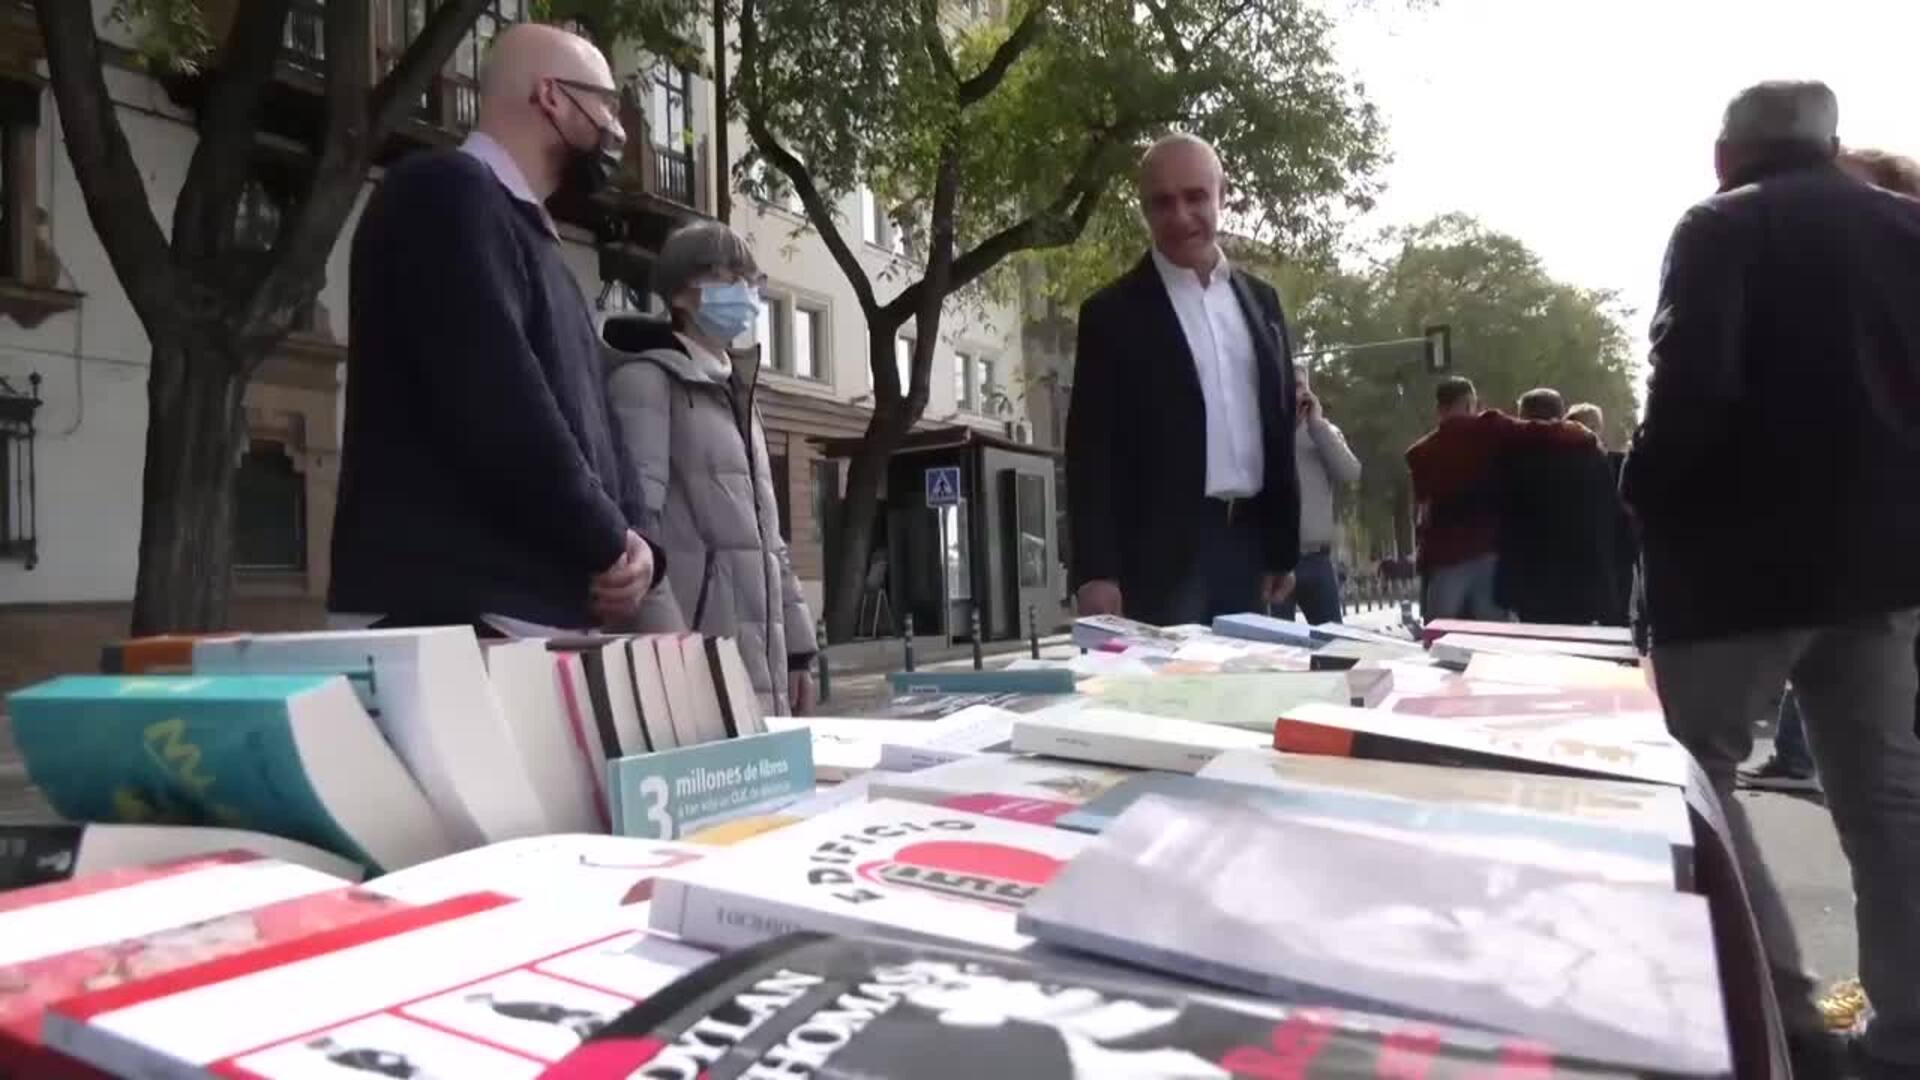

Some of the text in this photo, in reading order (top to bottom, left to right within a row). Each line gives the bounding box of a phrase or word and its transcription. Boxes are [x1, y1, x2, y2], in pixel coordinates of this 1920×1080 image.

[640, 776, 672, 840] 3
[676, 766, 742, 798] millones
[743, 762, 758, 781] de
[759, 758, 788, 775] libros
[624, 969, 825, 1080] DYLAN
[735, 962, 920, 1080] HOMAS
